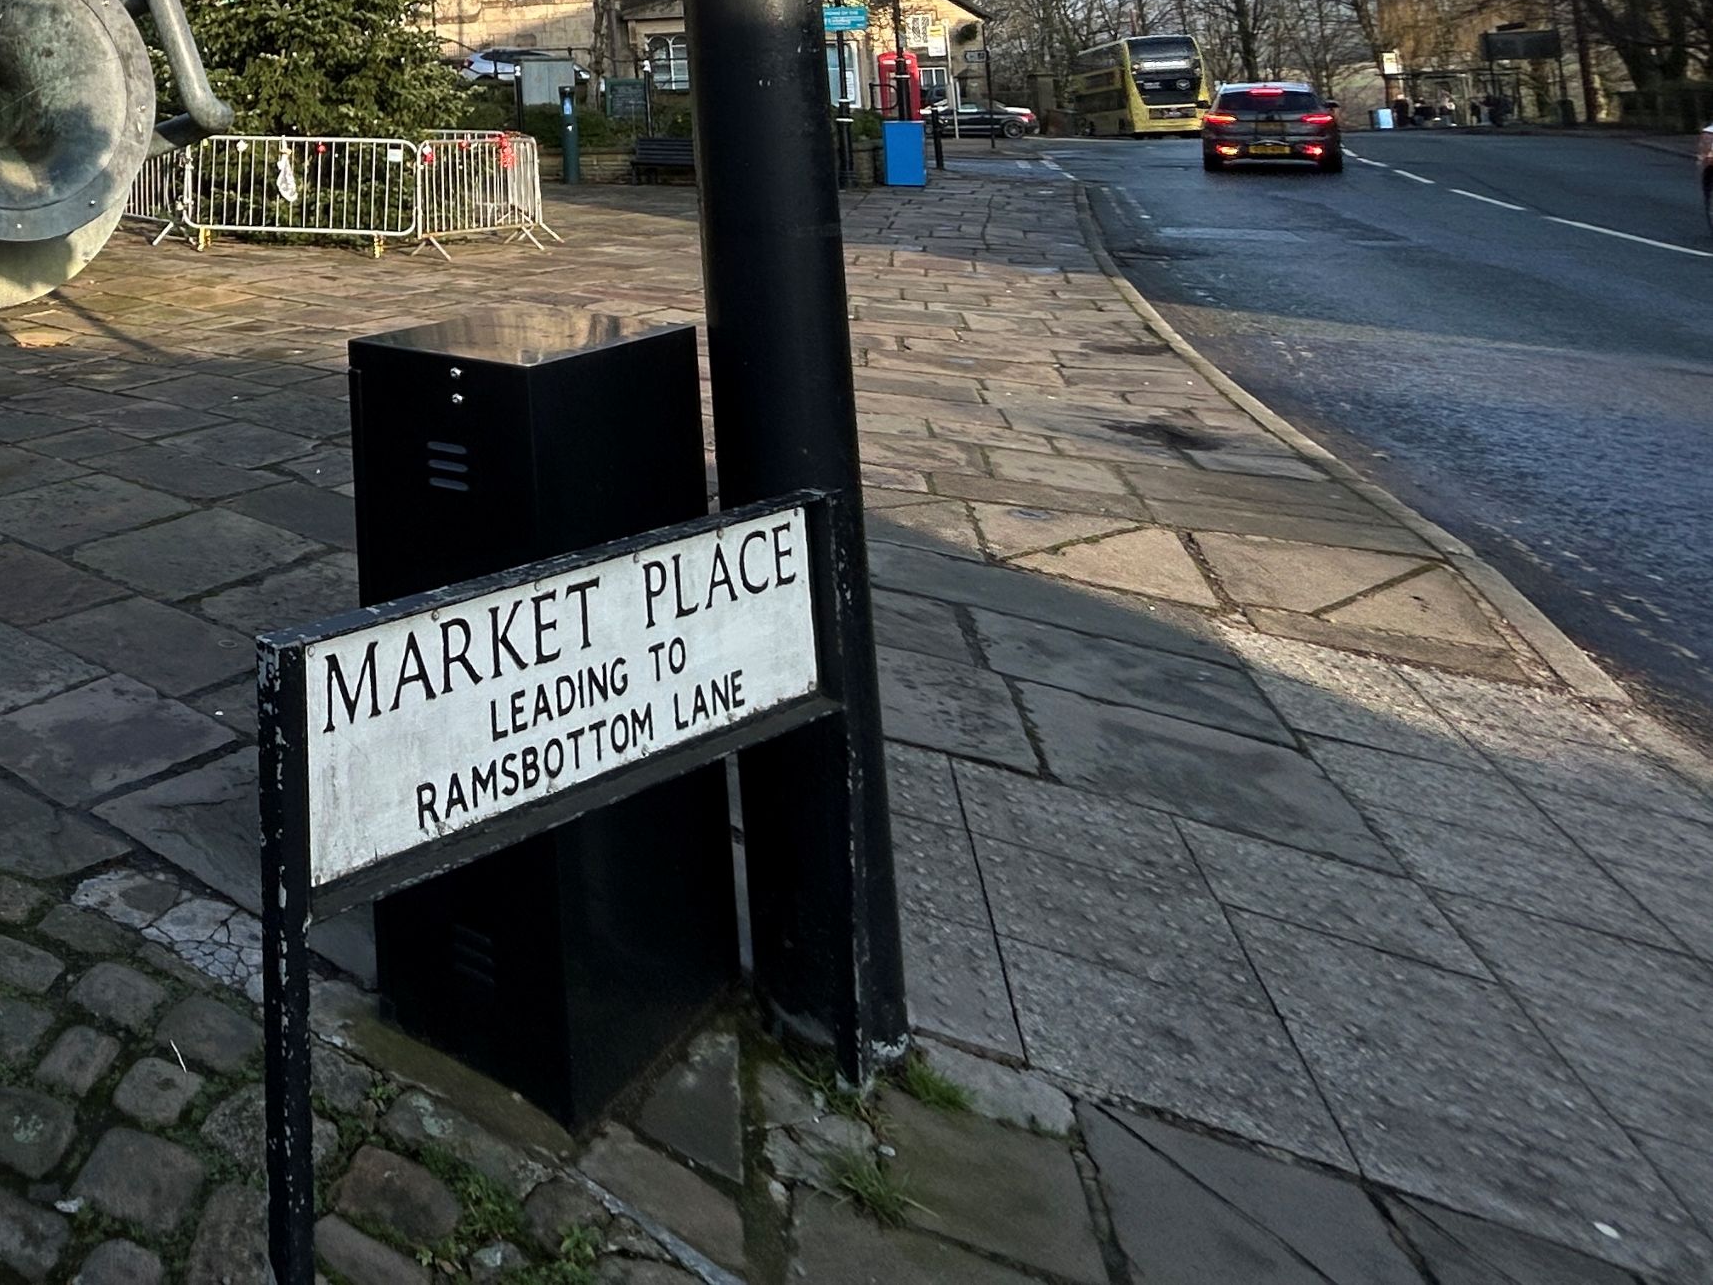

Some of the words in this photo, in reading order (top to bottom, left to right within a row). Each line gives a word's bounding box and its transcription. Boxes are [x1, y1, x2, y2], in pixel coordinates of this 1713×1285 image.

[322, 576, 601, 734] MARKET
[641, 521, 797, 630] PLACE
[489, 657, 629, 742] LEADING
[647, 636, 687, 682] TO
[416, 701, 655, 830] RAMSBOTTOM
[673, 668, 746, 731] LANE
